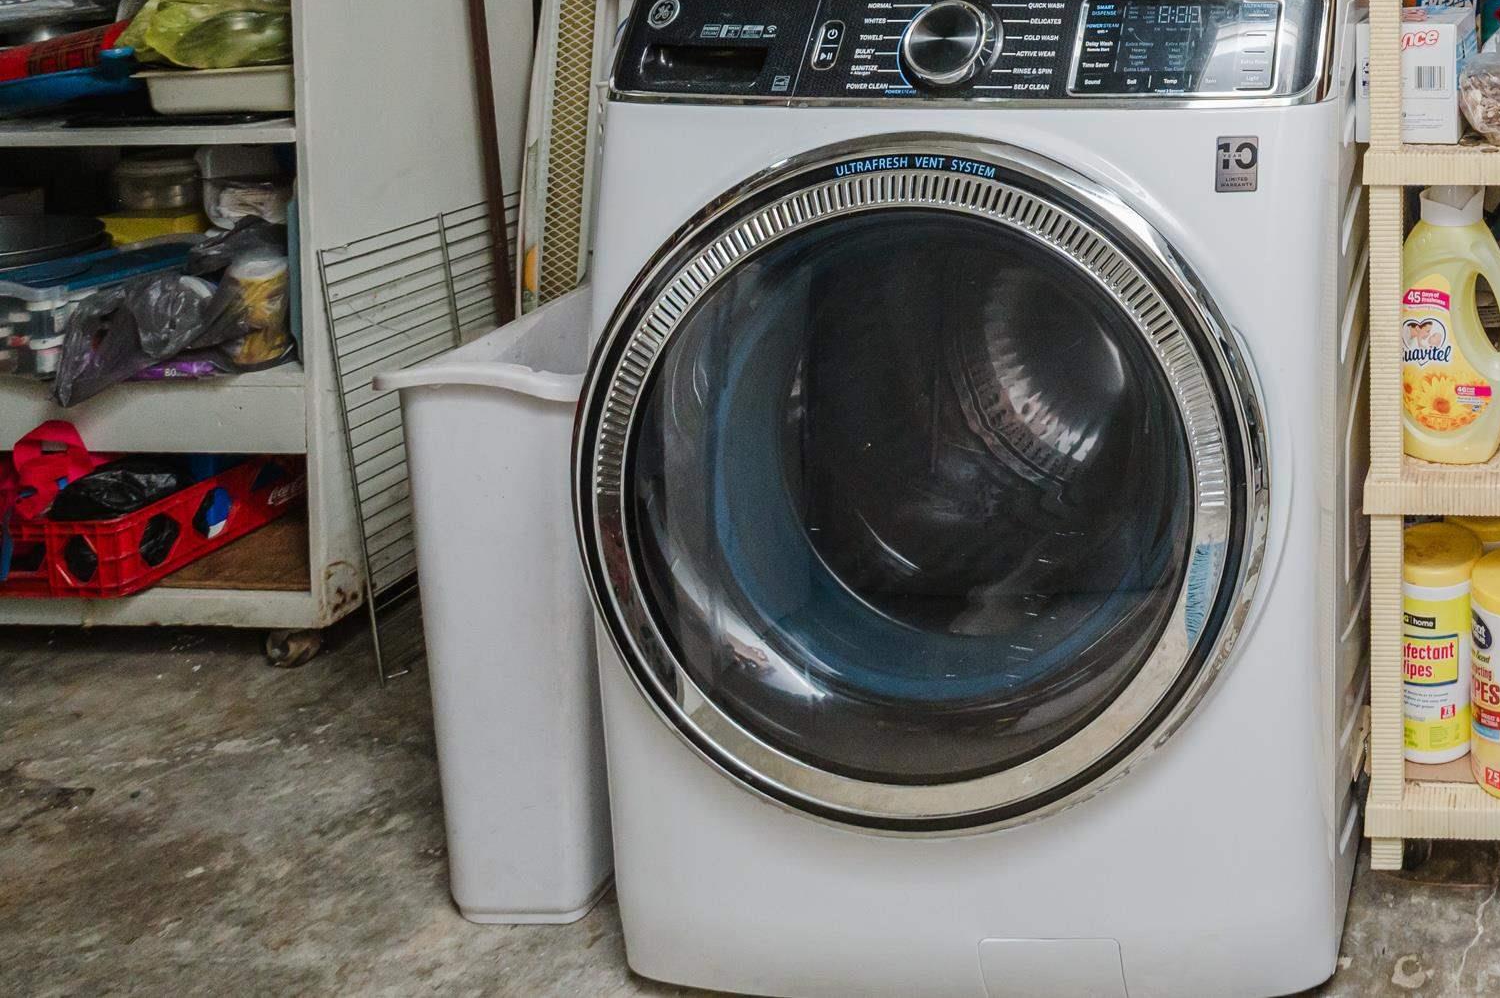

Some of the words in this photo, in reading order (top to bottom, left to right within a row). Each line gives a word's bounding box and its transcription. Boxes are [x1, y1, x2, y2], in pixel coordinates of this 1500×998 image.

[1217, 142, 1257, 169] 10
[836, 156, 908, 176] ULTRAFRESH
[915, 156, 946, 169] VENT
[951, 158, 996, 178] SYSTEM
[1408, 291, 1421, 303] 45
[1413, 618, 1434, 628] home
[1487, 769, 1500, 783] 75
